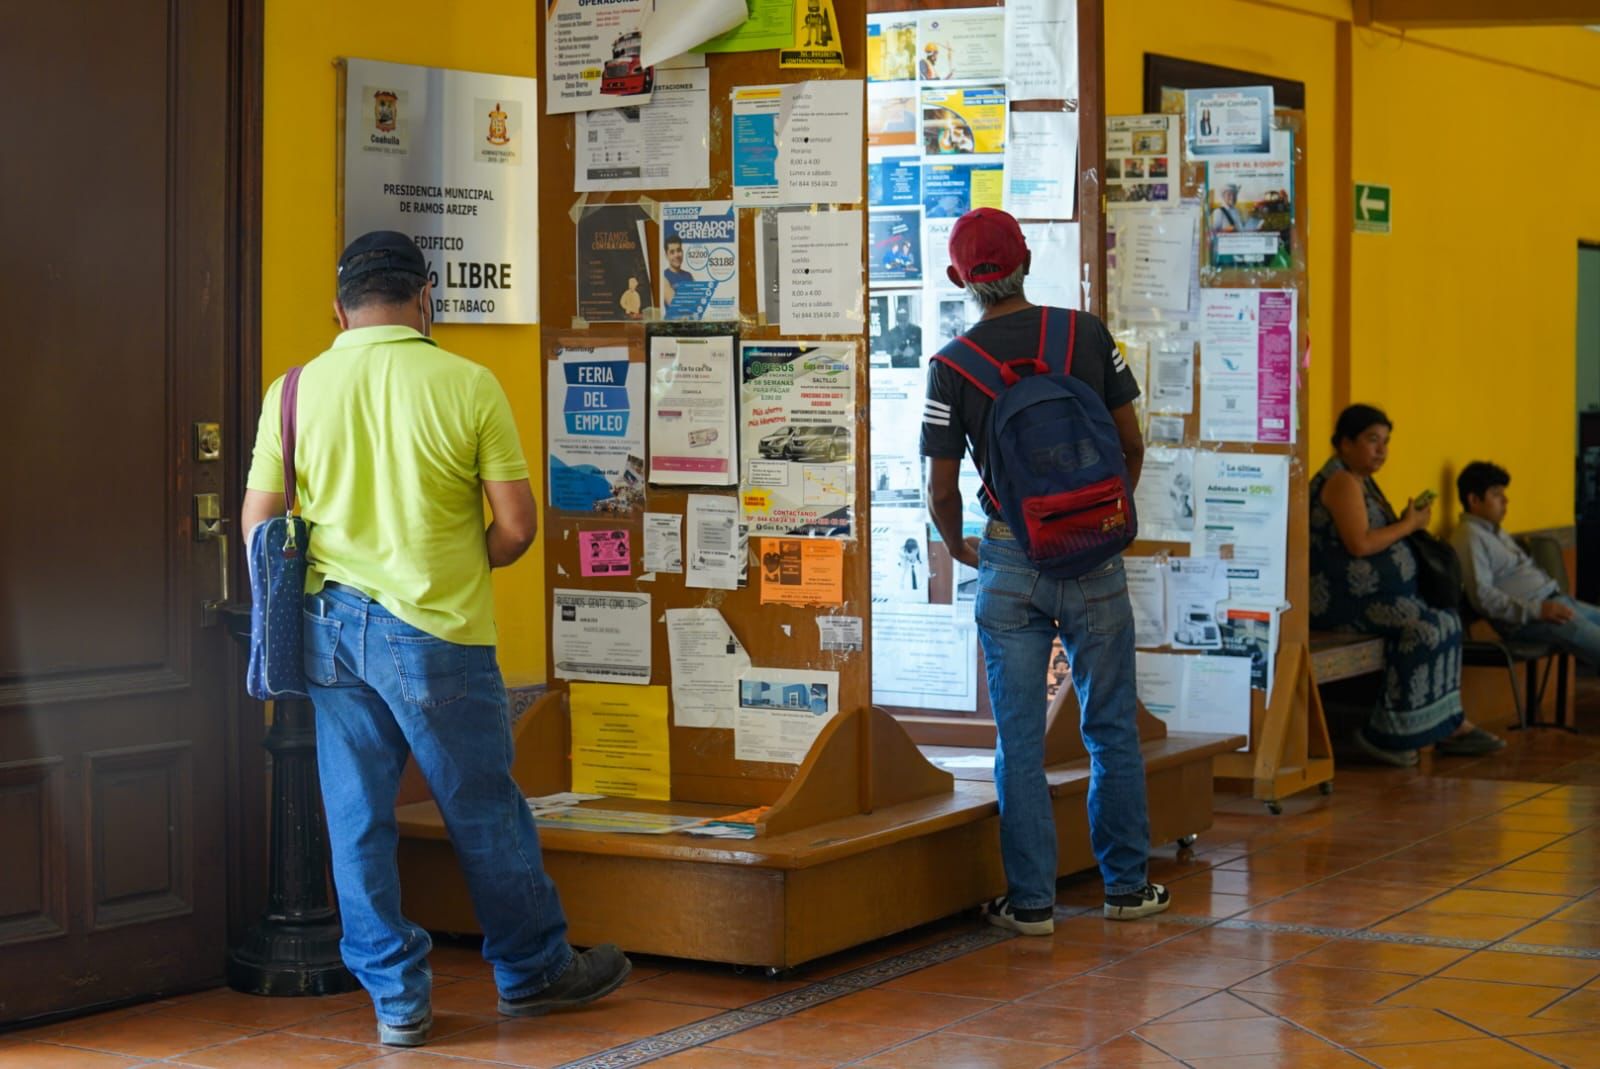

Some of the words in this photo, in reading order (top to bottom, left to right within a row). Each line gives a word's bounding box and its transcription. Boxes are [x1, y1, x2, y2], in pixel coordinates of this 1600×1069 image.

[654, 83, 693, 91] ESTACIONES
[370, 134, 400, 146] Coahuila
[384, 184, 442, 198] PRESIDENCIA
[444, 186, 494, 200] MUNICIPAL
[400, 202, 411, 214] DE
[414, 203, 444, 214] RAMOS
[446, 204, 478, 216] ARIZPE
[664, 208, 699, 216] ESTAMOS
[674, 220, 735, 232] OPERADOR
[594, 232, 629, 241] ESTAMOS
[678, 230, 730, 240] GENERAL
[414, 236, 463, 251] EDIFICIO
[592, 241, 636, 250] CONTRATANDO
[709, 257, 734, 266] $3188
[446, 262, 512, 289] LIBRE
[436, 300, 450, 312] DE
[453, 299, 495, 313] TABACO
[763, 363, 795, 372] PESOS
[578, 366, 614, 383] FERIA
[584, 391, 608, 408] DEL
[575, 414, 622, 431] EMPLEO
